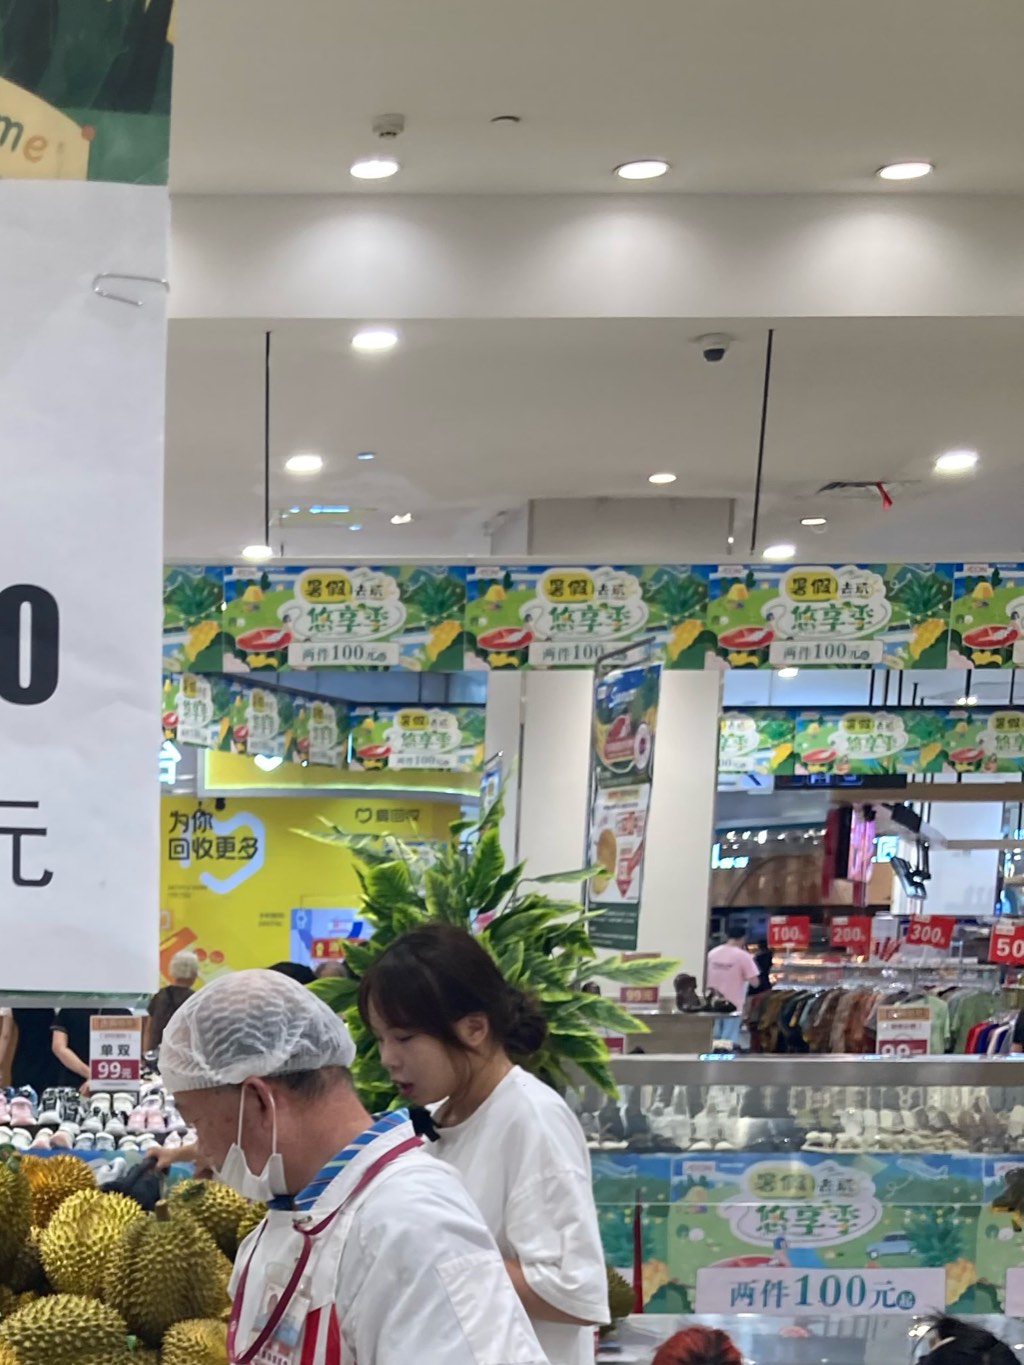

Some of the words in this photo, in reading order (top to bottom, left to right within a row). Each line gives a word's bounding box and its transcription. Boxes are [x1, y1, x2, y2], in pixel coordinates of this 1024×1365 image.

[169, 808, 214, 834] 为你
[169, 836, 259, 861] 回收更多
